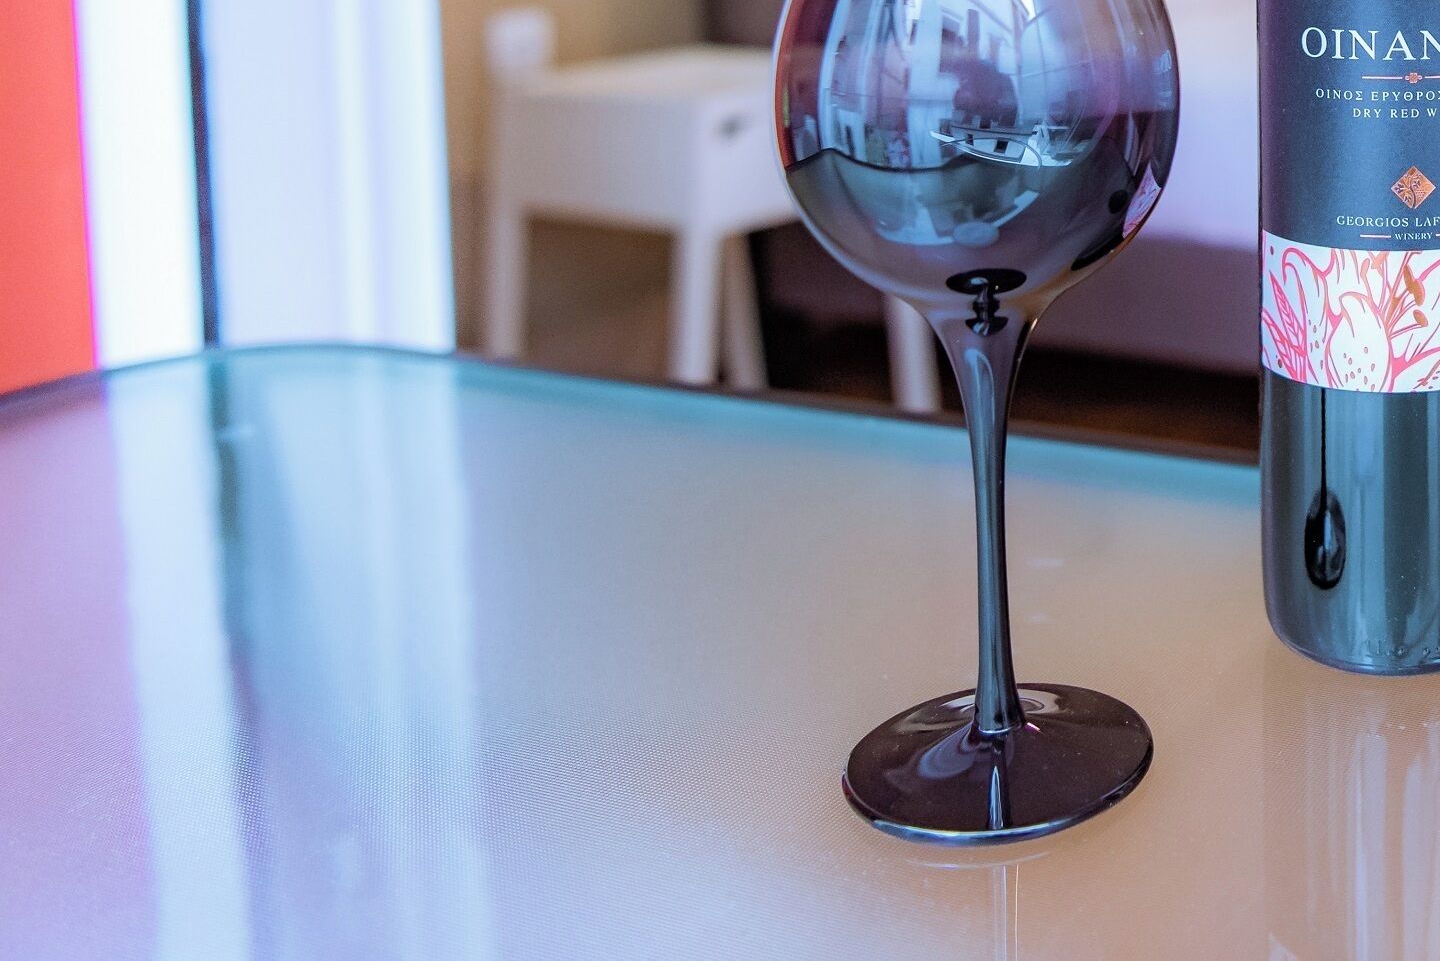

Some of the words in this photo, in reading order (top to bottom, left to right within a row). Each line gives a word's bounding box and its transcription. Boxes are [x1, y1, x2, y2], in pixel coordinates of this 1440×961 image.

[1315, 87, 1364, 101] ΟΙΝΟΣ
[1352, 107, 1382, 119] DRY
[1390, 107, 1420, 119] RED
[1336, 215, 1409, 228] GEORGIOS
[1394, 231, 1434, 241] WINERY
